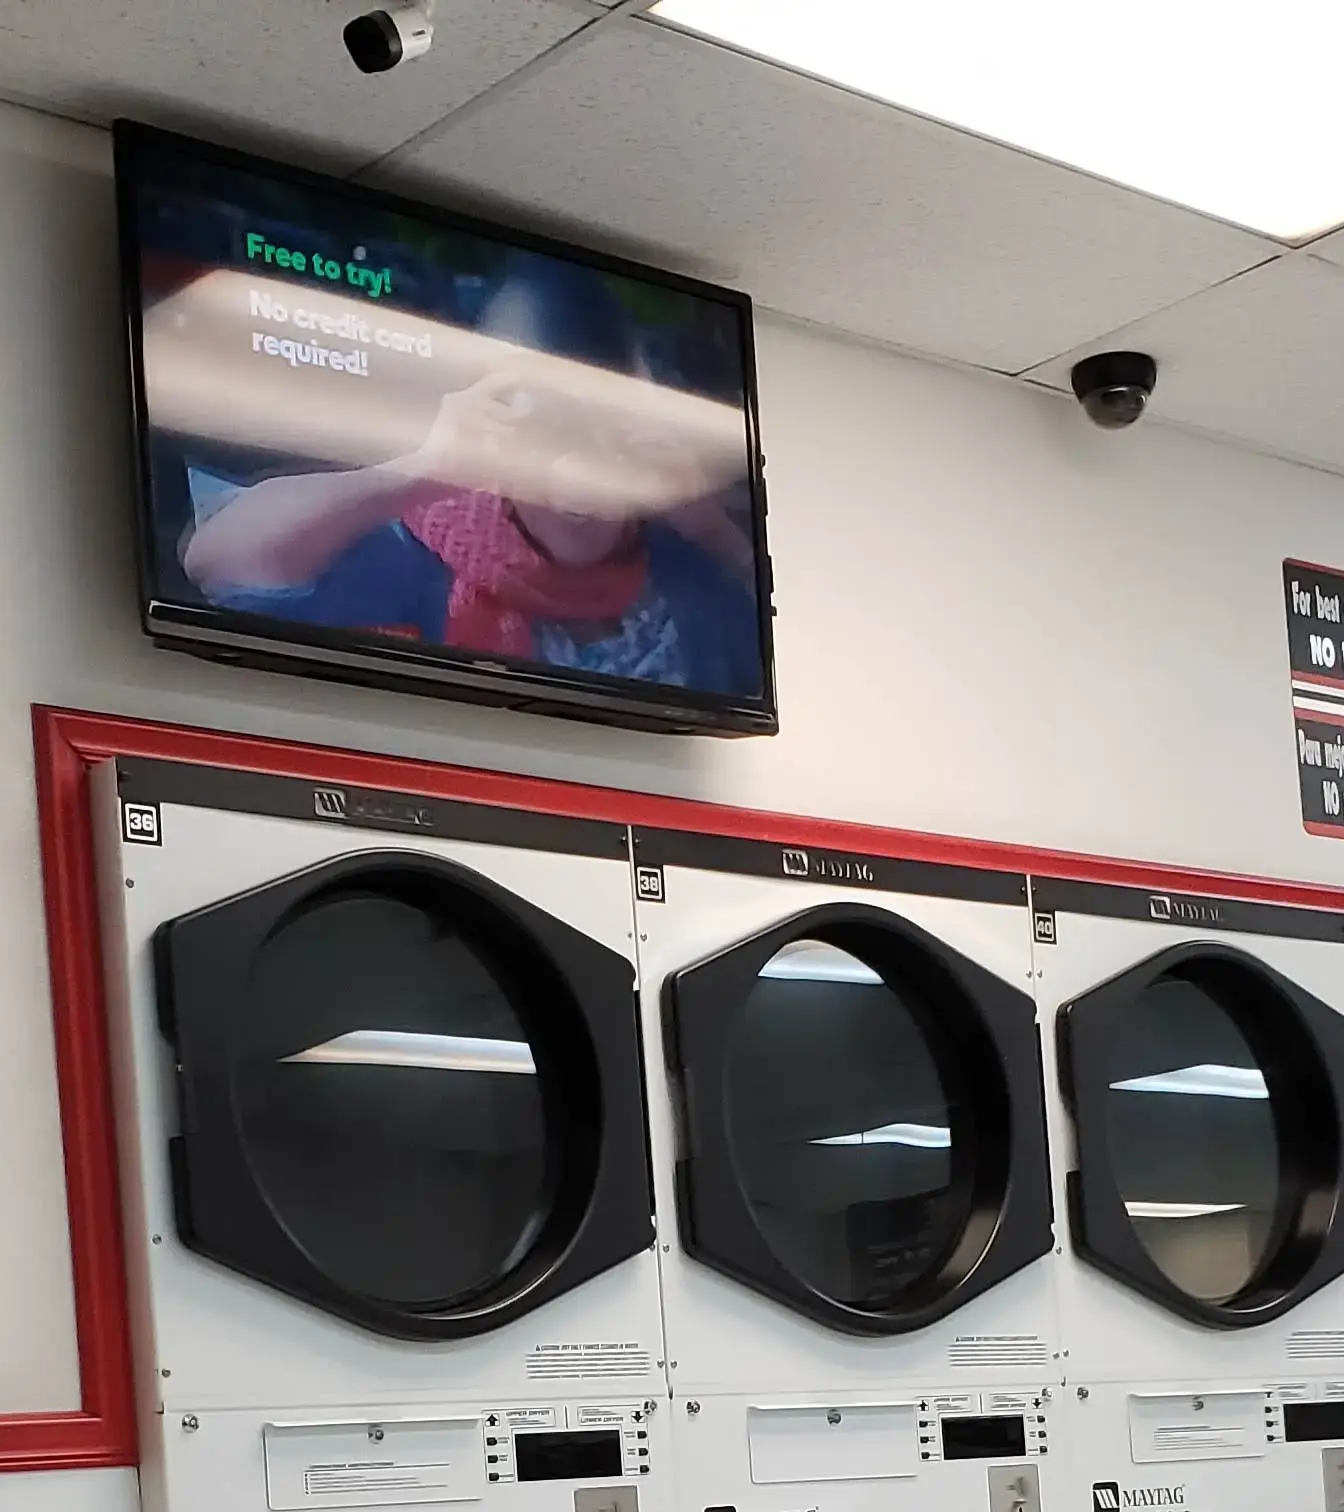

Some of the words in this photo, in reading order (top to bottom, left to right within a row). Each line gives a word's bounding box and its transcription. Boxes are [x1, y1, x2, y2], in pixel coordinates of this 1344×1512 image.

[246, 233, 306, 272] Free
[312, 253, 341, 280] to
[345, 262, 392, 297] try!
[249, 289, 288, 322] No
[293, 308, 371, 343] credit
[374, 328, 432, 358] card
[252, 332, 369, 377] required!
[1291, 581, 1311, 617] For
[1316, 585, 1340, 623] best
[1309, 634, 1336, 668] NO
[1298, 729, 1322, 767] Para
[1322, 781, 1340, 816] NO
[129, 812, 154, 831] 36
[640, 875, 659, 892] 38
[1037, 920, 1053, 935] 40
[1122, 1486, 1185, 1507] MAYTAG
